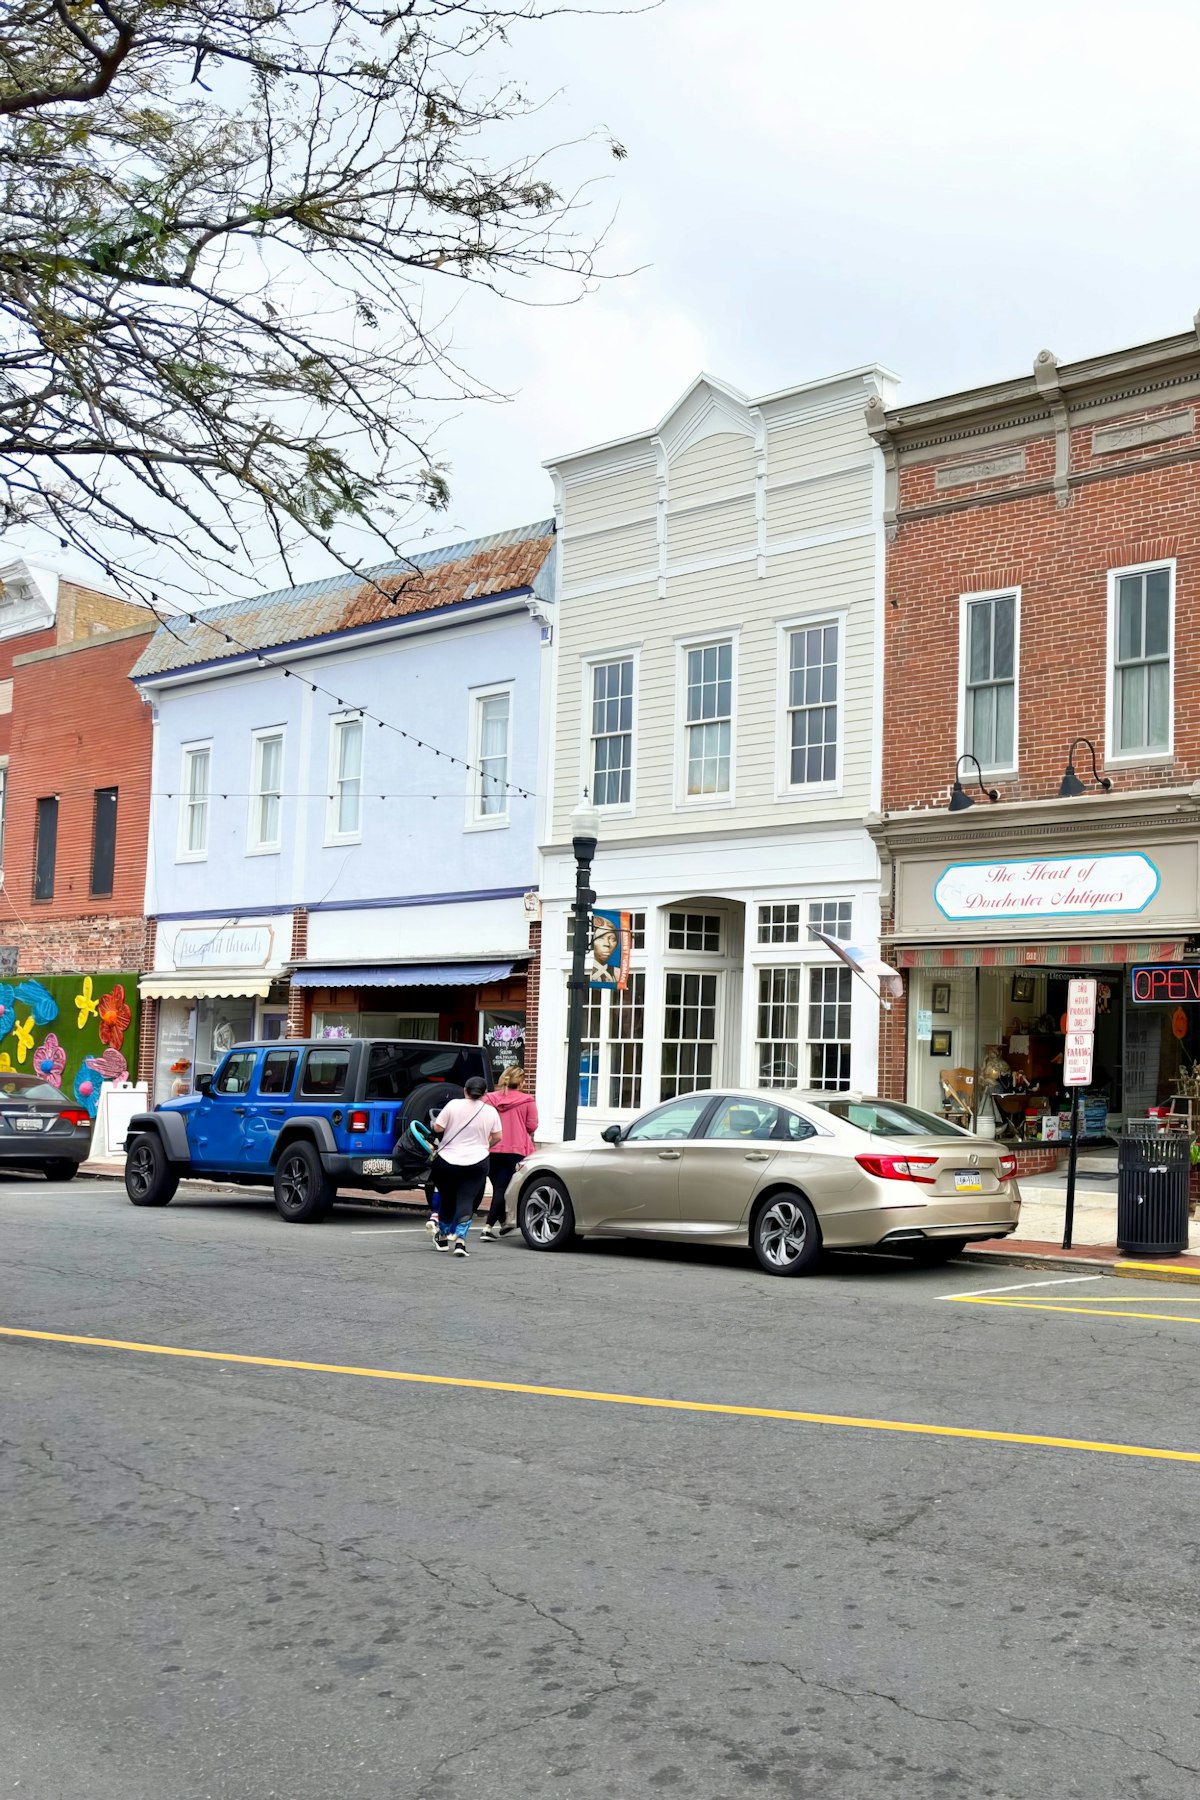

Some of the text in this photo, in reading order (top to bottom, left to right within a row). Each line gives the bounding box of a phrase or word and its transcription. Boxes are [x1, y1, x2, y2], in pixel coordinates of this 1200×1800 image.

[985, 860, 1098, 883] The Heart of
[962, 887, 1123, 909] Dorchester Antiques
[1135, 970, 1200, 999] OPEN
[1074, 1036, 1085, 1045] NO
